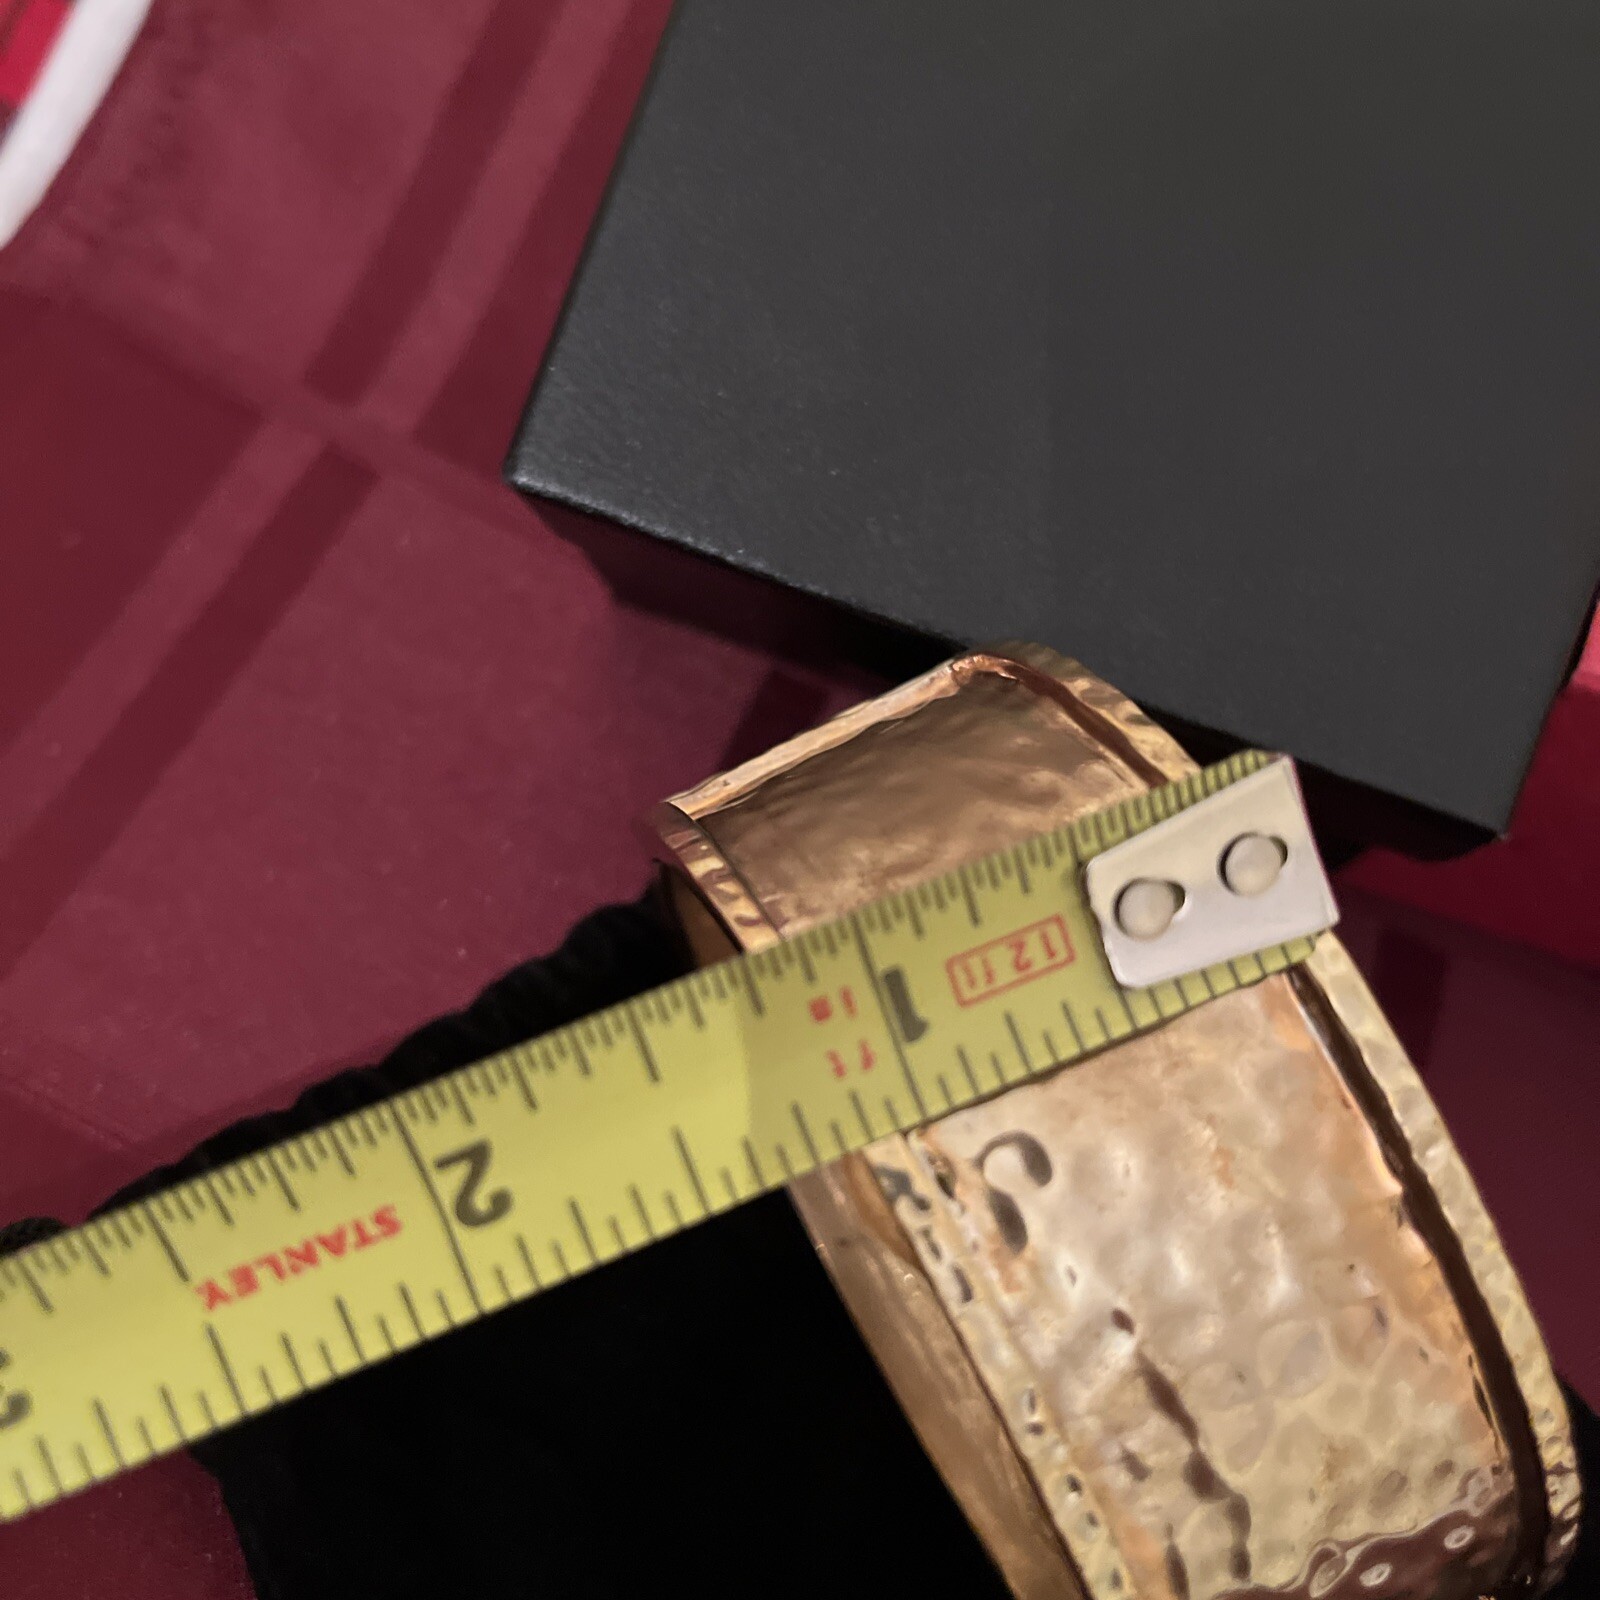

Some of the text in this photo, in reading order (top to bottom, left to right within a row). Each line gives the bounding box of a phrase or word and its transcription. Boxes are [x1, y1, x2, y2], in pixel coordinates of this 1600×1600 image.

[957, 928, 1057, 991] 12 ft
[808, 985, 857, 1022] in
[883, 965, 930, 1043] 1
[826, 1039, 877, 1079] ft
[434, 1138, 514, 1228] 2
[194, 1204, 402, 1311] STANLEY
